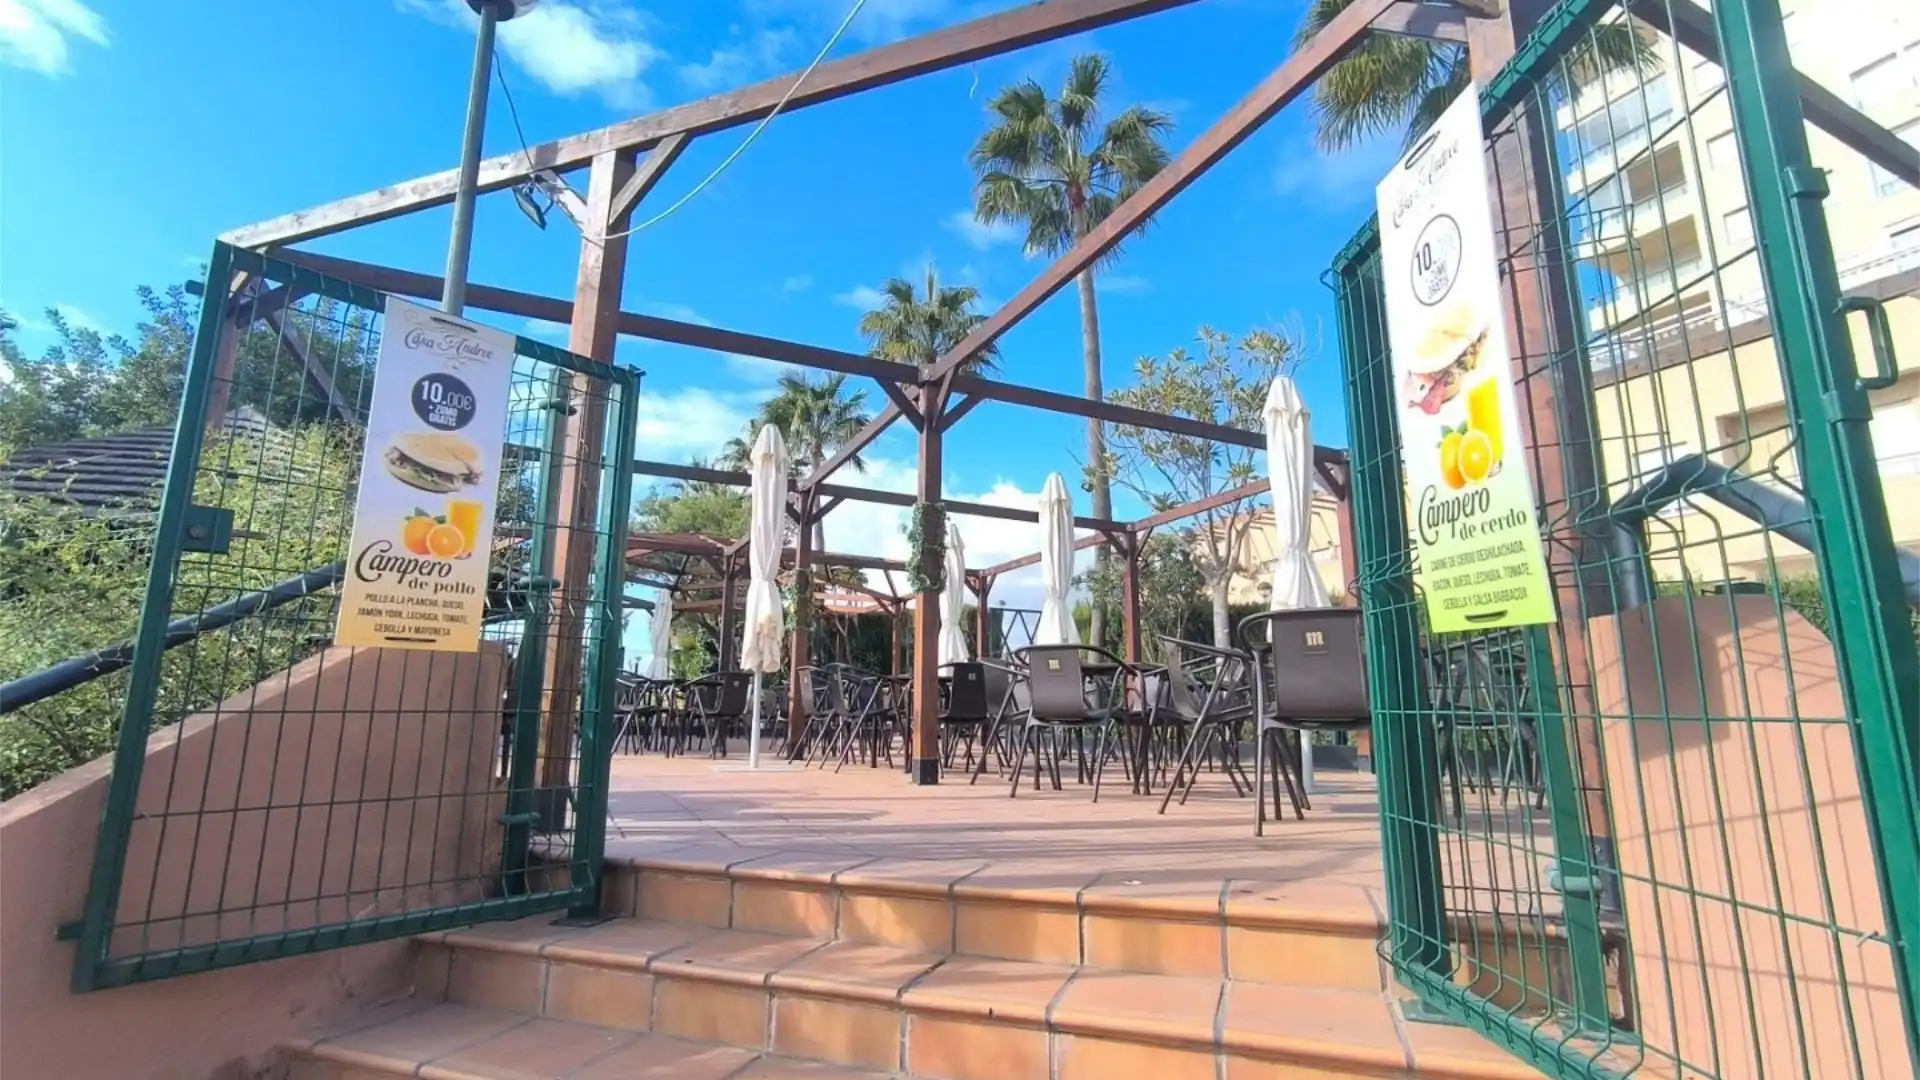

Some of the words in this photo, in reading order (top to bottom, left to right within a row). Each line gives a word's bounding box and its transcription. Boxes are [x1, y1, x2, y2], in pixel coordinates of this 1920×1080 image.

[404, 327, 434, 350] Casa
[421, 379, 473, 411] 10.00€
[1418, 484, 1490, 546] Campero
[1460, 521, 1476, 541] de
[1481, 508, 1527, 535] cerdo
[355, 539, 452, 584] Campero
[365, 593, 389, 604] POLLO
[396, 595, 406, 605] LA
[408, 576, 429, 591] de
[434, 581, 476, 595] pollo
[374, 623, 406, 634] CEBOLLA
